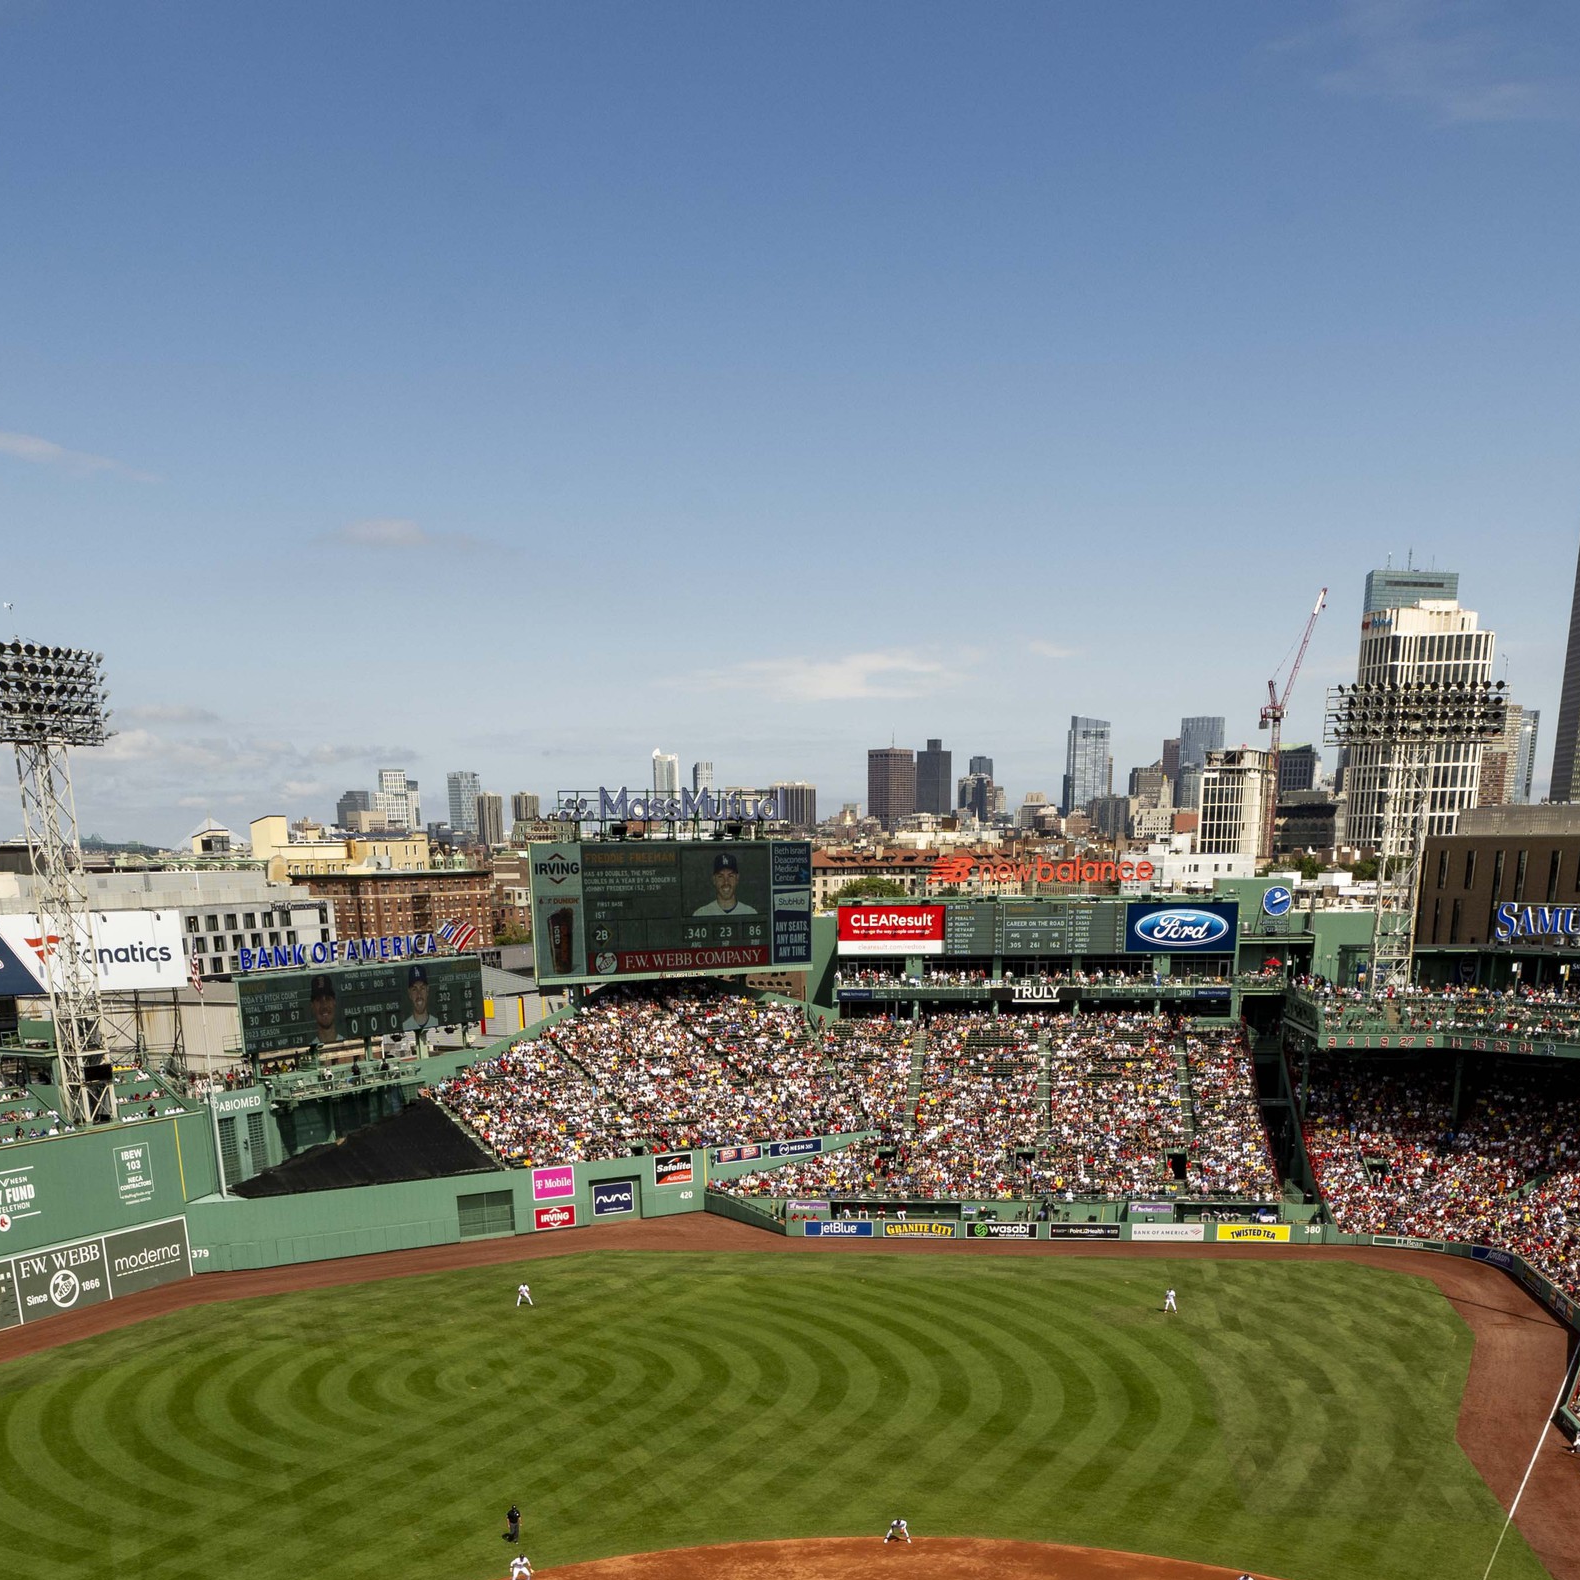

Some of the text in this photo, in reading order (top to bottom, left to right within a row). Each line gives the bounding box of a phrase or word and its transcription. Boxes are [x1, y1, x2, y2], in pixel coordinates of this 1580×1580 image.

[774, 847, 789, 855] Beth
[584, 852, 676, 863] FREDDIE FREEMAN
[774, 856, 807, 864] Deaconess
[534, 860, 580, 876] IRVING
[775, 865, 799, 873] Medical
[850, 914, 932, 927] CLEAResult
[720, 925, 762, 937] 23 86
[775, 922, 787, 931] ANY
[1153, 915, 1209, 939] Ford
[595, 930, 609, 941] 2B
[777, 934, 789, 944] ANY
[240, 934, 437, 970] BANK OF AMERICA
[779, 946, 806, 957] ANY TIME
[625, 950, 762, 969] F.W. WEBB COMPANY
[281, 991, 298, 1000] COUNT
[1012, 985, 1061, 1000] TRULY
[344, 1002, 399, 1015] BALLS STRIKES OUTS
[220, 1095, 261, 1112] ABIOMED
[121, 1148, 142, 1161] IBEW
[126, 1160, 141, 1171] 103
[656, 1162, 691, 1173] Safelite
[10, 1176, 28, 1185] NESN
[128, 1175, 143, 1183] NECA
[545, 1176, 571, 1188] Mobile
[120, 1180, 152, 1191] CONTRACTORS
[5, 1184, 35, 1203] FUND
[680, 1191, 693, 1200] 420
[540, 1212, 569, 1222] IRVING
[820, 1222, 857, 1235] jetBlue
[886, 1224, 930, 1235] GRANITE
[931, 1223, 954, 1236] CITY
[989, 1224, 1030, 1234] wasabi
[1304, 1226, 1321, 1234] 380
[1231, 1229, 1276, 1240] TWISTED TEA
[114, 1243, 181, 1272] moderna
[192, 1249, 209, 1259] 379
[19, 1243, 100, 1279] F.W. WEBB
[26, 1278, 100, 1306] Since 1866
